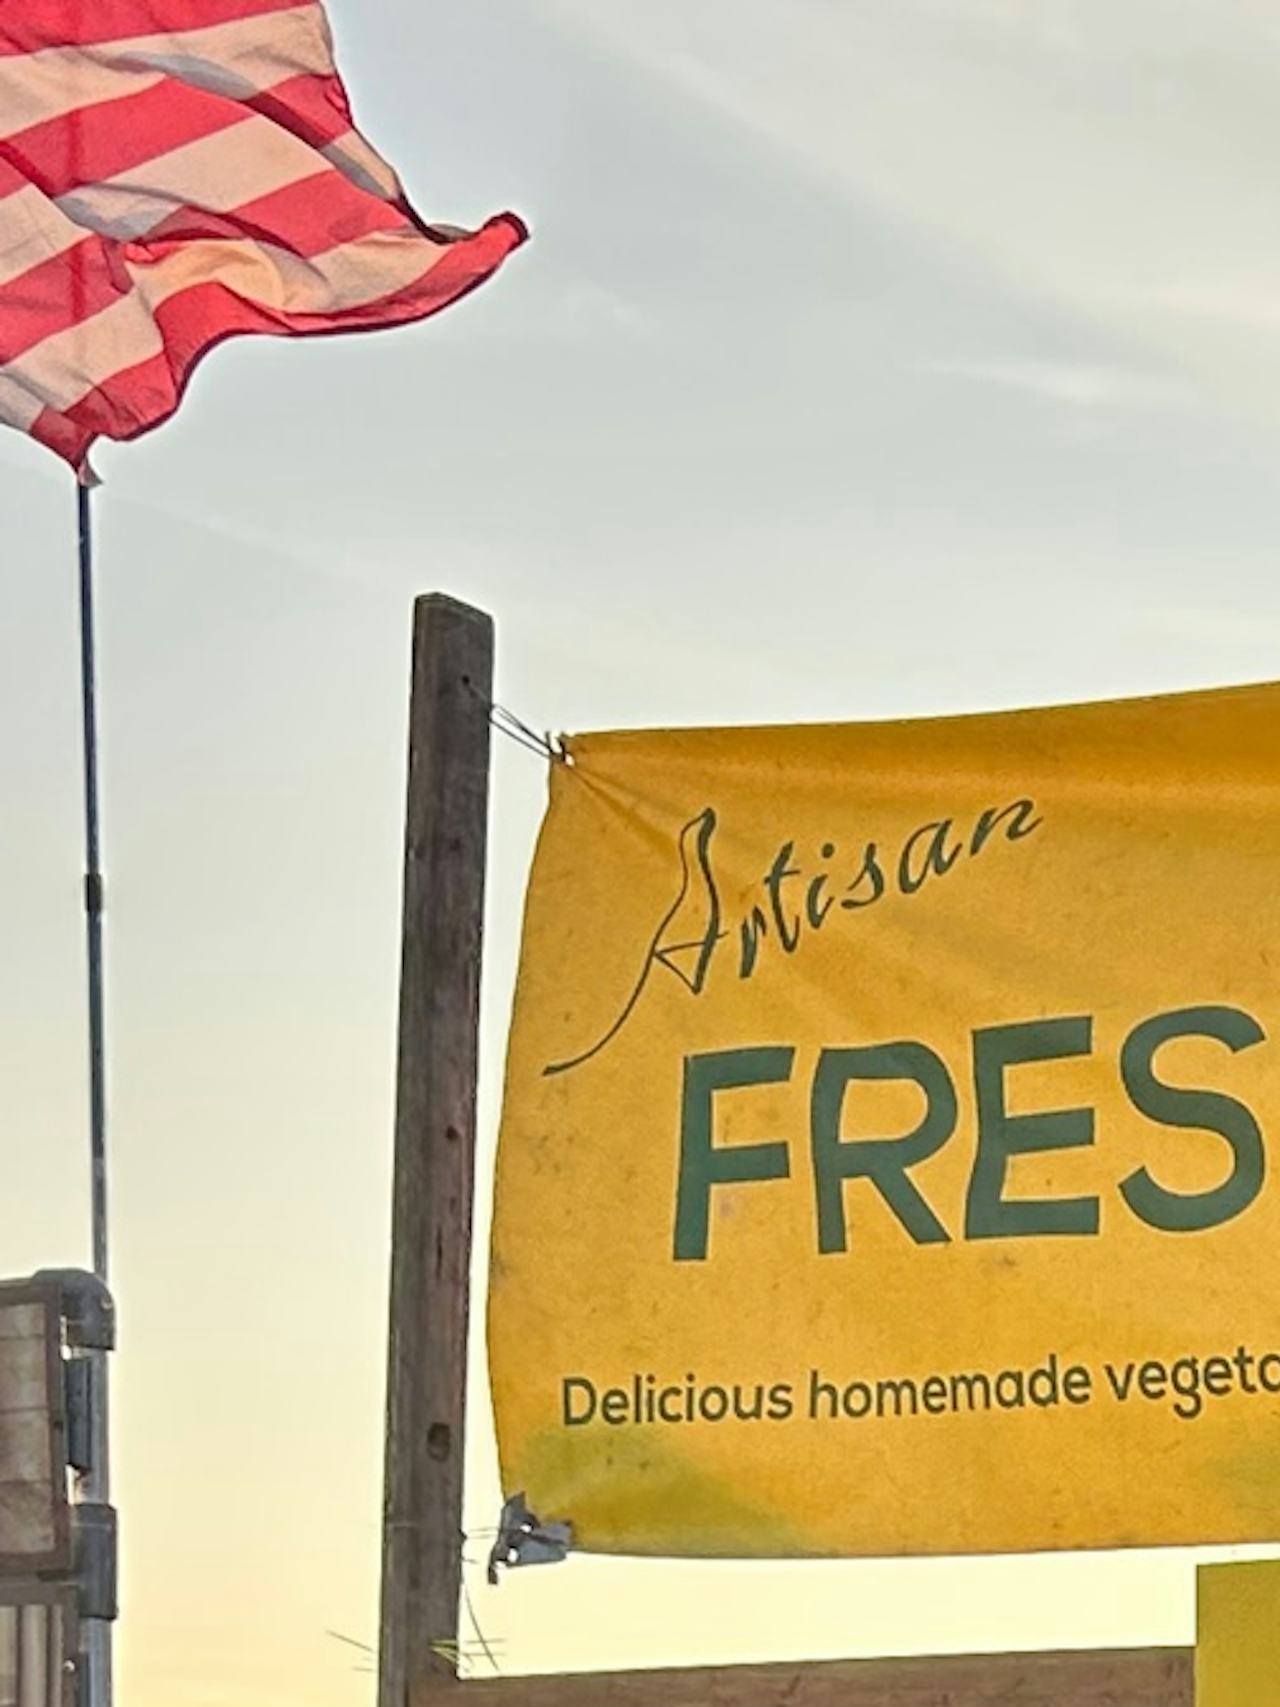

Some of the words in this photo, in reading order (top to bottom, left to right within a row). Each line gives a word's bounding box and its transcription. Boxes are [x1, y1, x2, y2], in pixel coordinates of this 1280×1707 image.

[542, 798, 1044, 1077] Artisan
[561, 1374, 794, 1426] Delicious
[808, 1354, 1092, 1418] homemade
